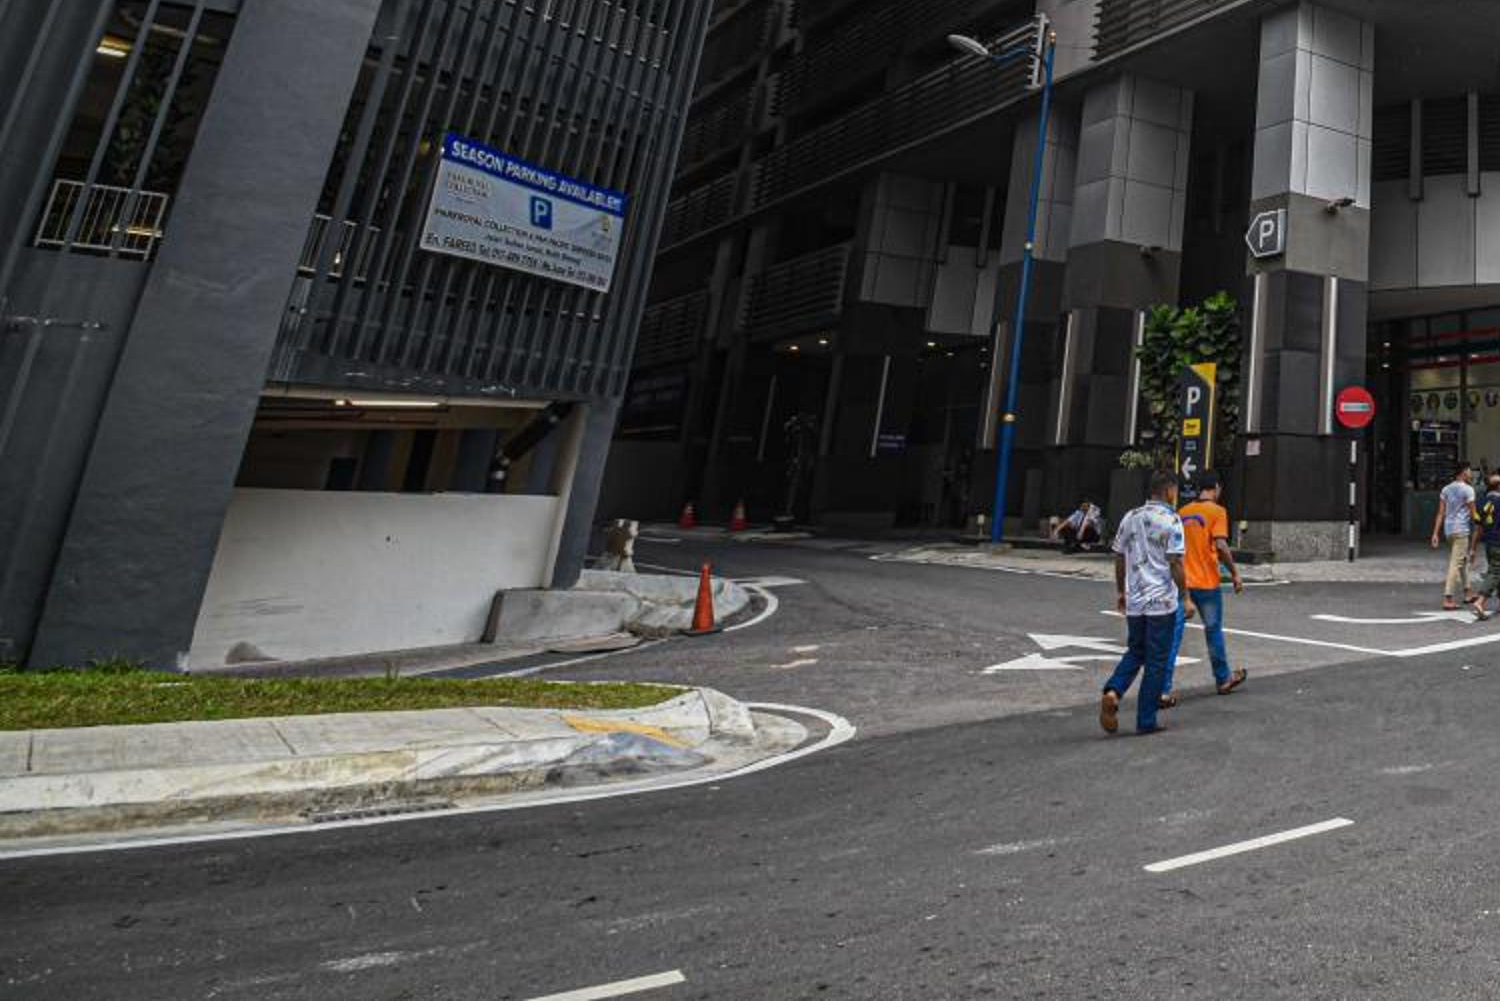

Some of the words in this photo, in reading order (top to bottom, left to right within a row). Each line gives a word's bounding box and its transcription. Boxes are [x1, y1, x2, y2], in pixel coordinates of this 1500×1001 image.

[451, 140, 505, 172] SEASON
[505, 161, 557, 190] PARKING
[534, 198, 549, 224] P
[1259, 220, 1275, 249] P
[1186, 386, 1201, 415] P
